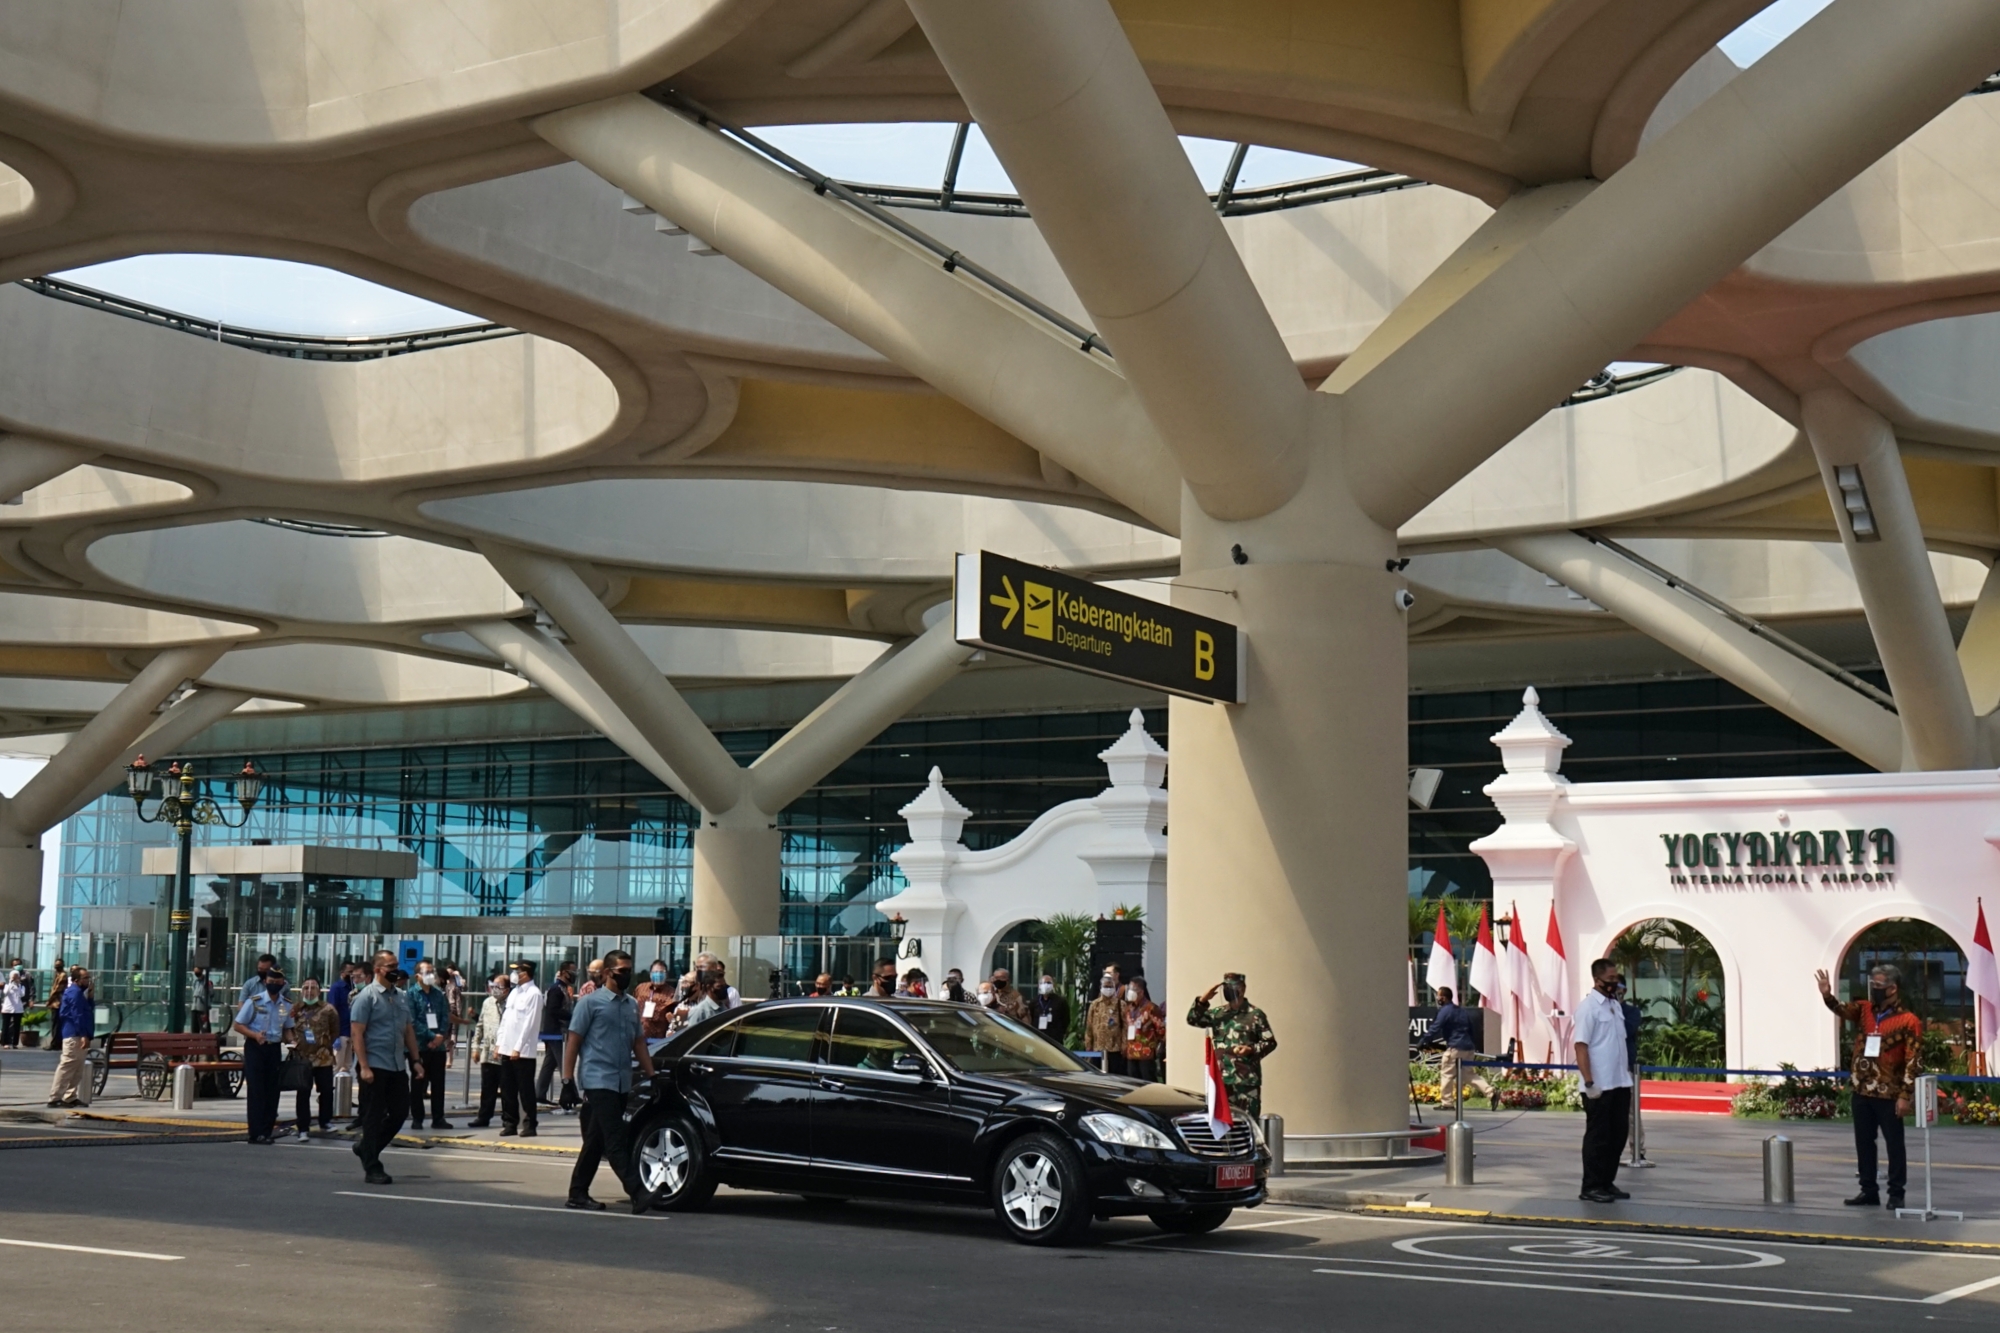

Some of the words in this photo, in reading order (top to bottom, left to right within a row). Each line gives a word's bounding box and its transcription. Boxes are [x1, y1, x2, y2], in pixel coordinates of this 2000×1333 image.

[1057, 589, 1173, 647] Keberangkatan
[1057, 624, 1112, 657] Departure
[1195, 629, 1215, 681] B
[1659, 828, 1896, 868] YOGYAKARTA
[1670, 873, 1809, 885] INTERNATIONAL
[1821, 872, 1894, 883] AIRPORT
[1408, 1018, 1433, 1037] AJU
[1221, 1166, 1251, 1180] INDONESIA
